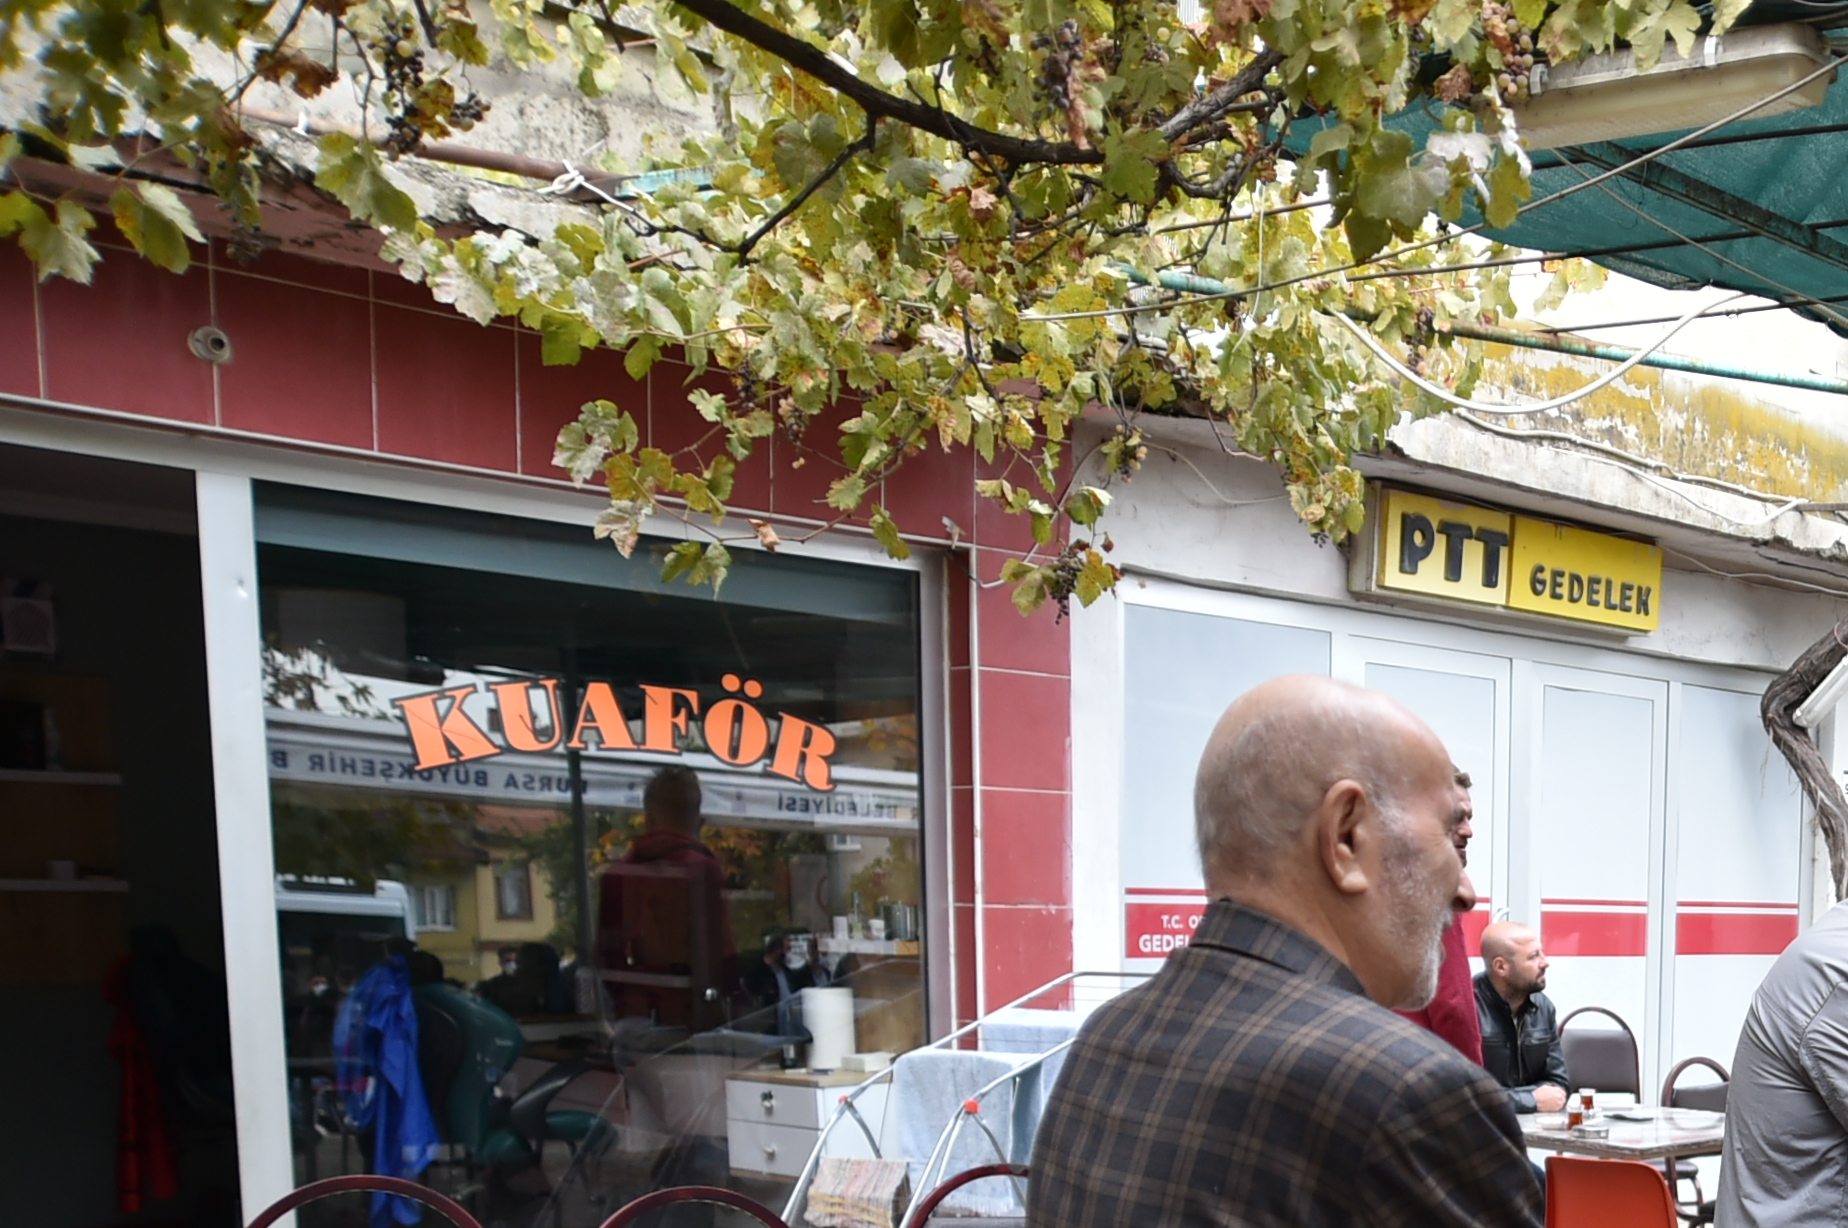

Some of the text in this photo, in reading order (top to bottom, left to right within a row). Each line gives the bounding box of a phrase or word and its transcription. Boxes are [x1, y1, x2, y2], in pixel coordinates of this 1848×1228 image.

[1399, 511, 1652, 617] PTT GEDELEK
[393, 672, 838, 793] KUAFÖR
[1160, 914, 1184, 929] T.C.
